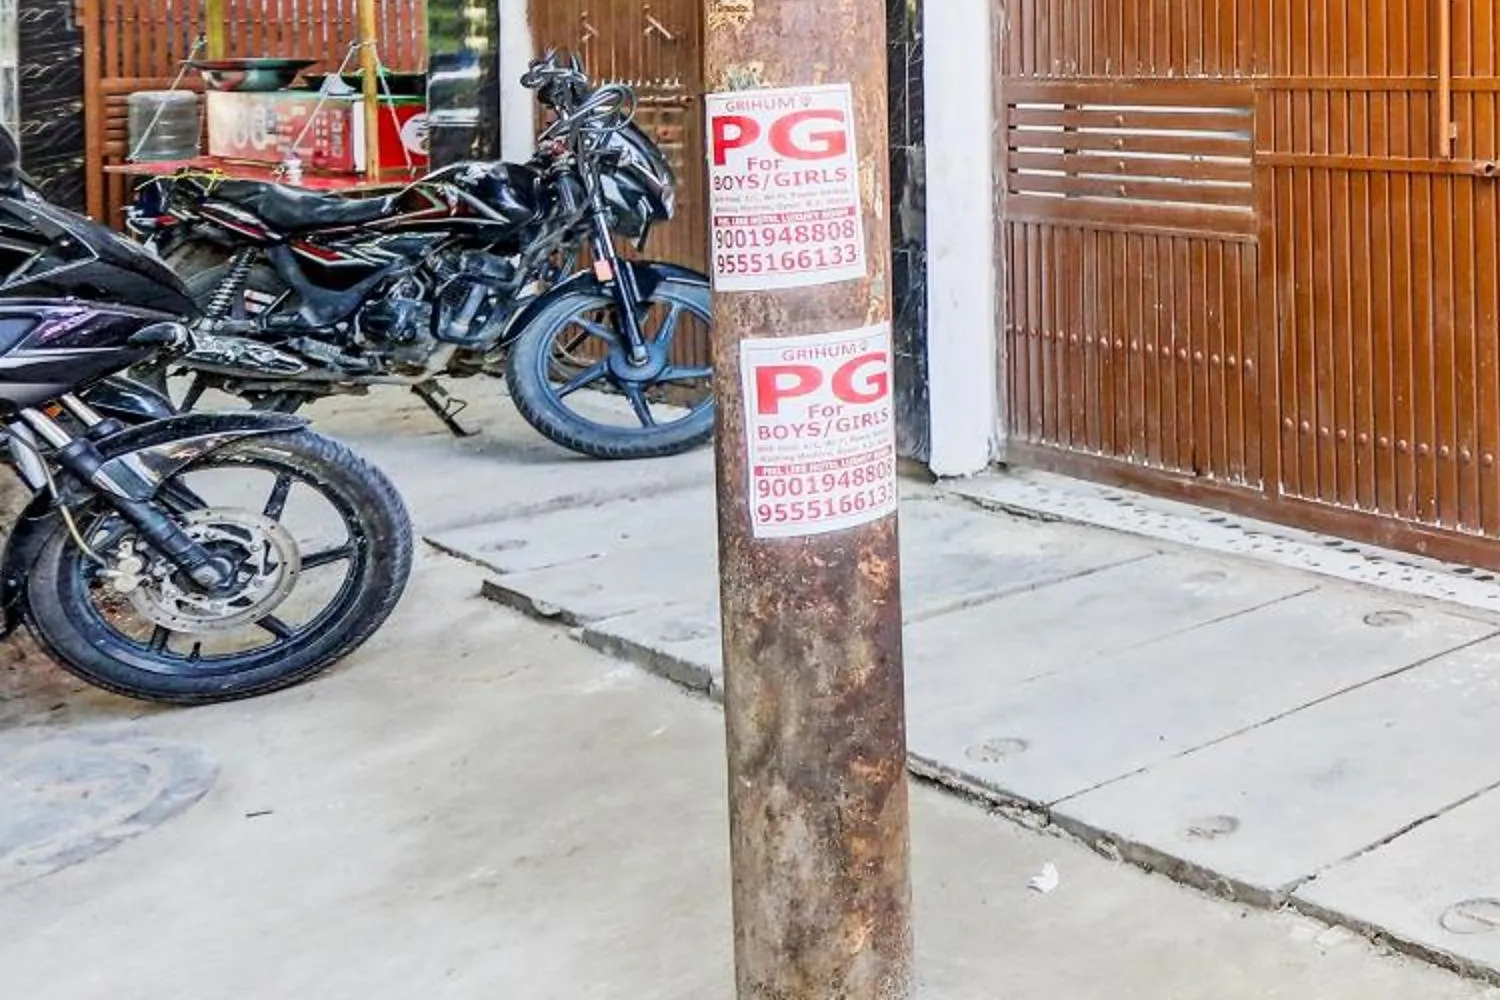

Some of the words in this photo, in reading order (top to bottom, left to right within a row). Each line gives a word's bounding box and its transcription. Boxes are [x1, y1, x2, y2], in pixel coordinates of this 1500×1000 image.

[711, 109, 848, 167] PG
[714, 167, 848, 192] BOYS/GIRLS
[747, 157, 785, 172] For
[715, 219, 856, 250] 9001948808
[717, 243, 858, 275] 9555166133
[755, 351, 889, 415] PG
[758, 406, 890, 441] BOYS/GIRLS
[808, 403, 845, 420] For
